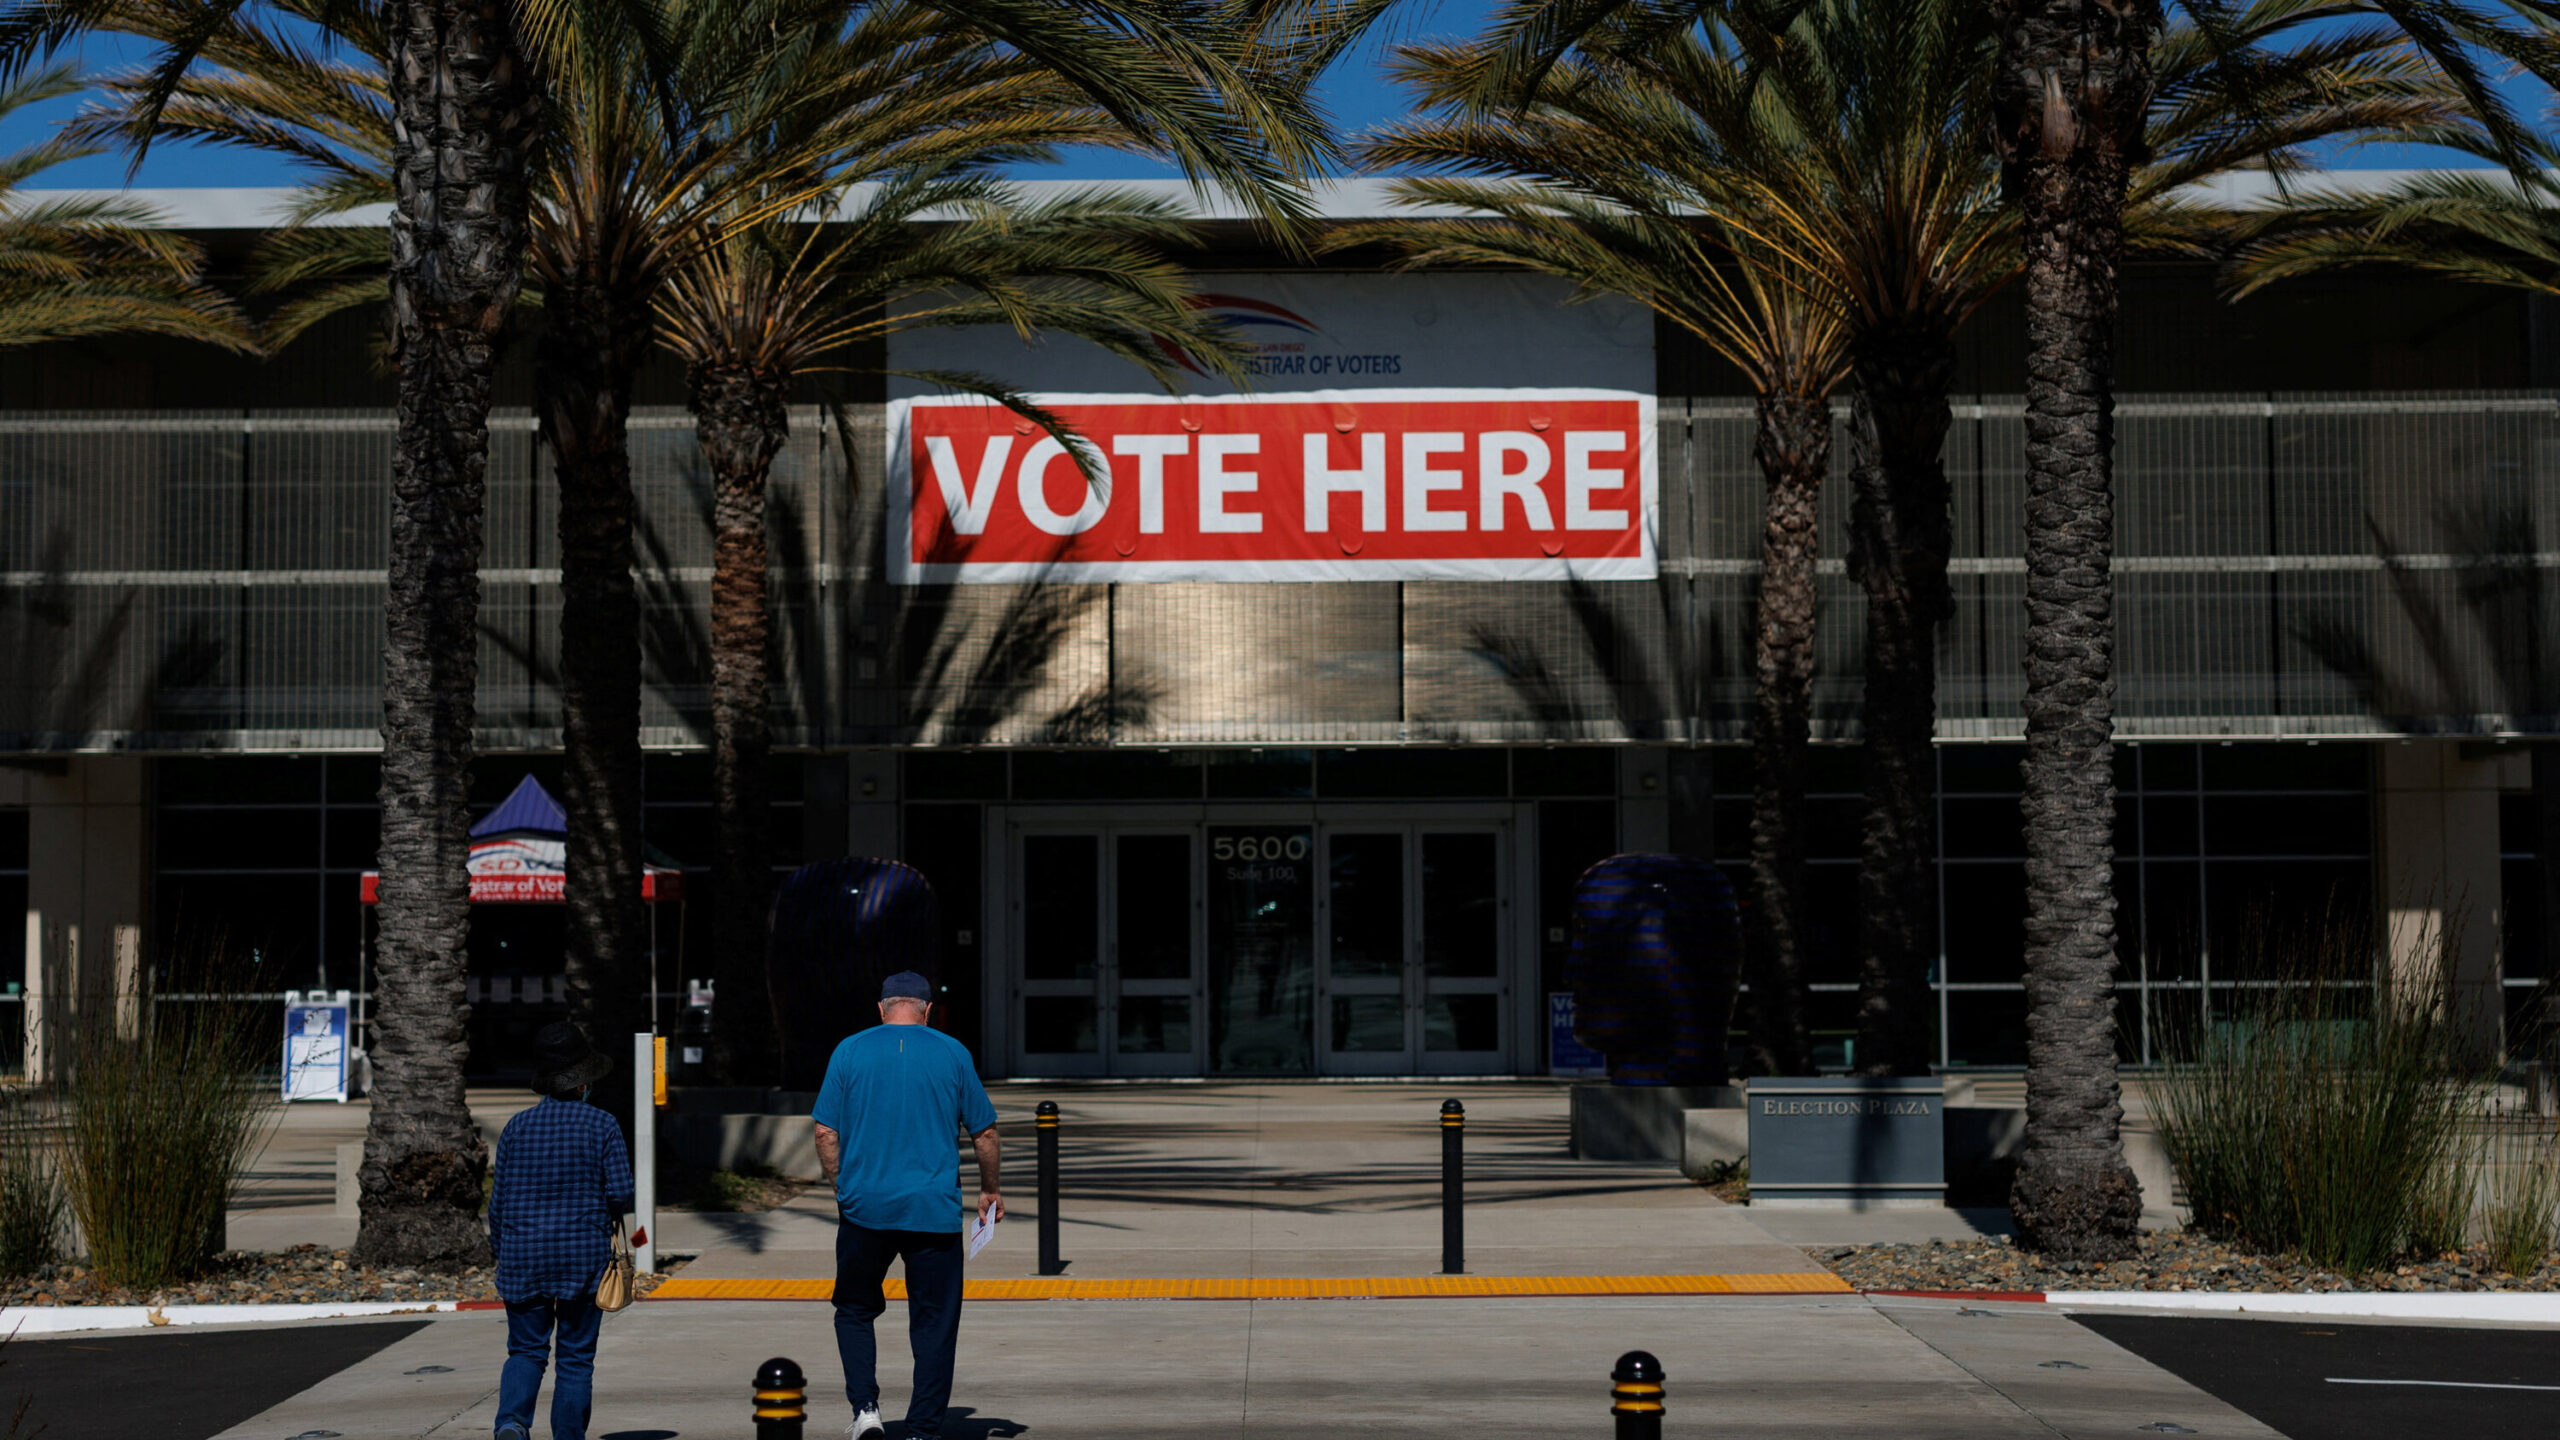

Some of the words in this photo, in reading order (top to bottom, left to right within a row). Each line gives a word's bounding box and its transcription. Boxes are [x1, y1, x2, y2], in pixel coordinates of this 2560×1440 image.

[1280, 343, 1305, 352] DIEGO
[1217, 355, 1305, 375] ISTRAR
[1309, 355, 1333, 375] OF
[1338, 354, 1402, 375] VOTERS
[924, 433, 1263, 536] VOTE
[1303, 430, 1630, 533] HERE
[1213, 836, 1306, 860] 5600
[1268, 865, 1295, 881] 100
[468, 878, 514, 897] gistrar
[516, 876, 535, 893] of
[535, 877, 565, 893] Vot
[1763, 1099, 1862, 1115] ELECTION
[1868, 1099, 1930, 1115] PLAZA
